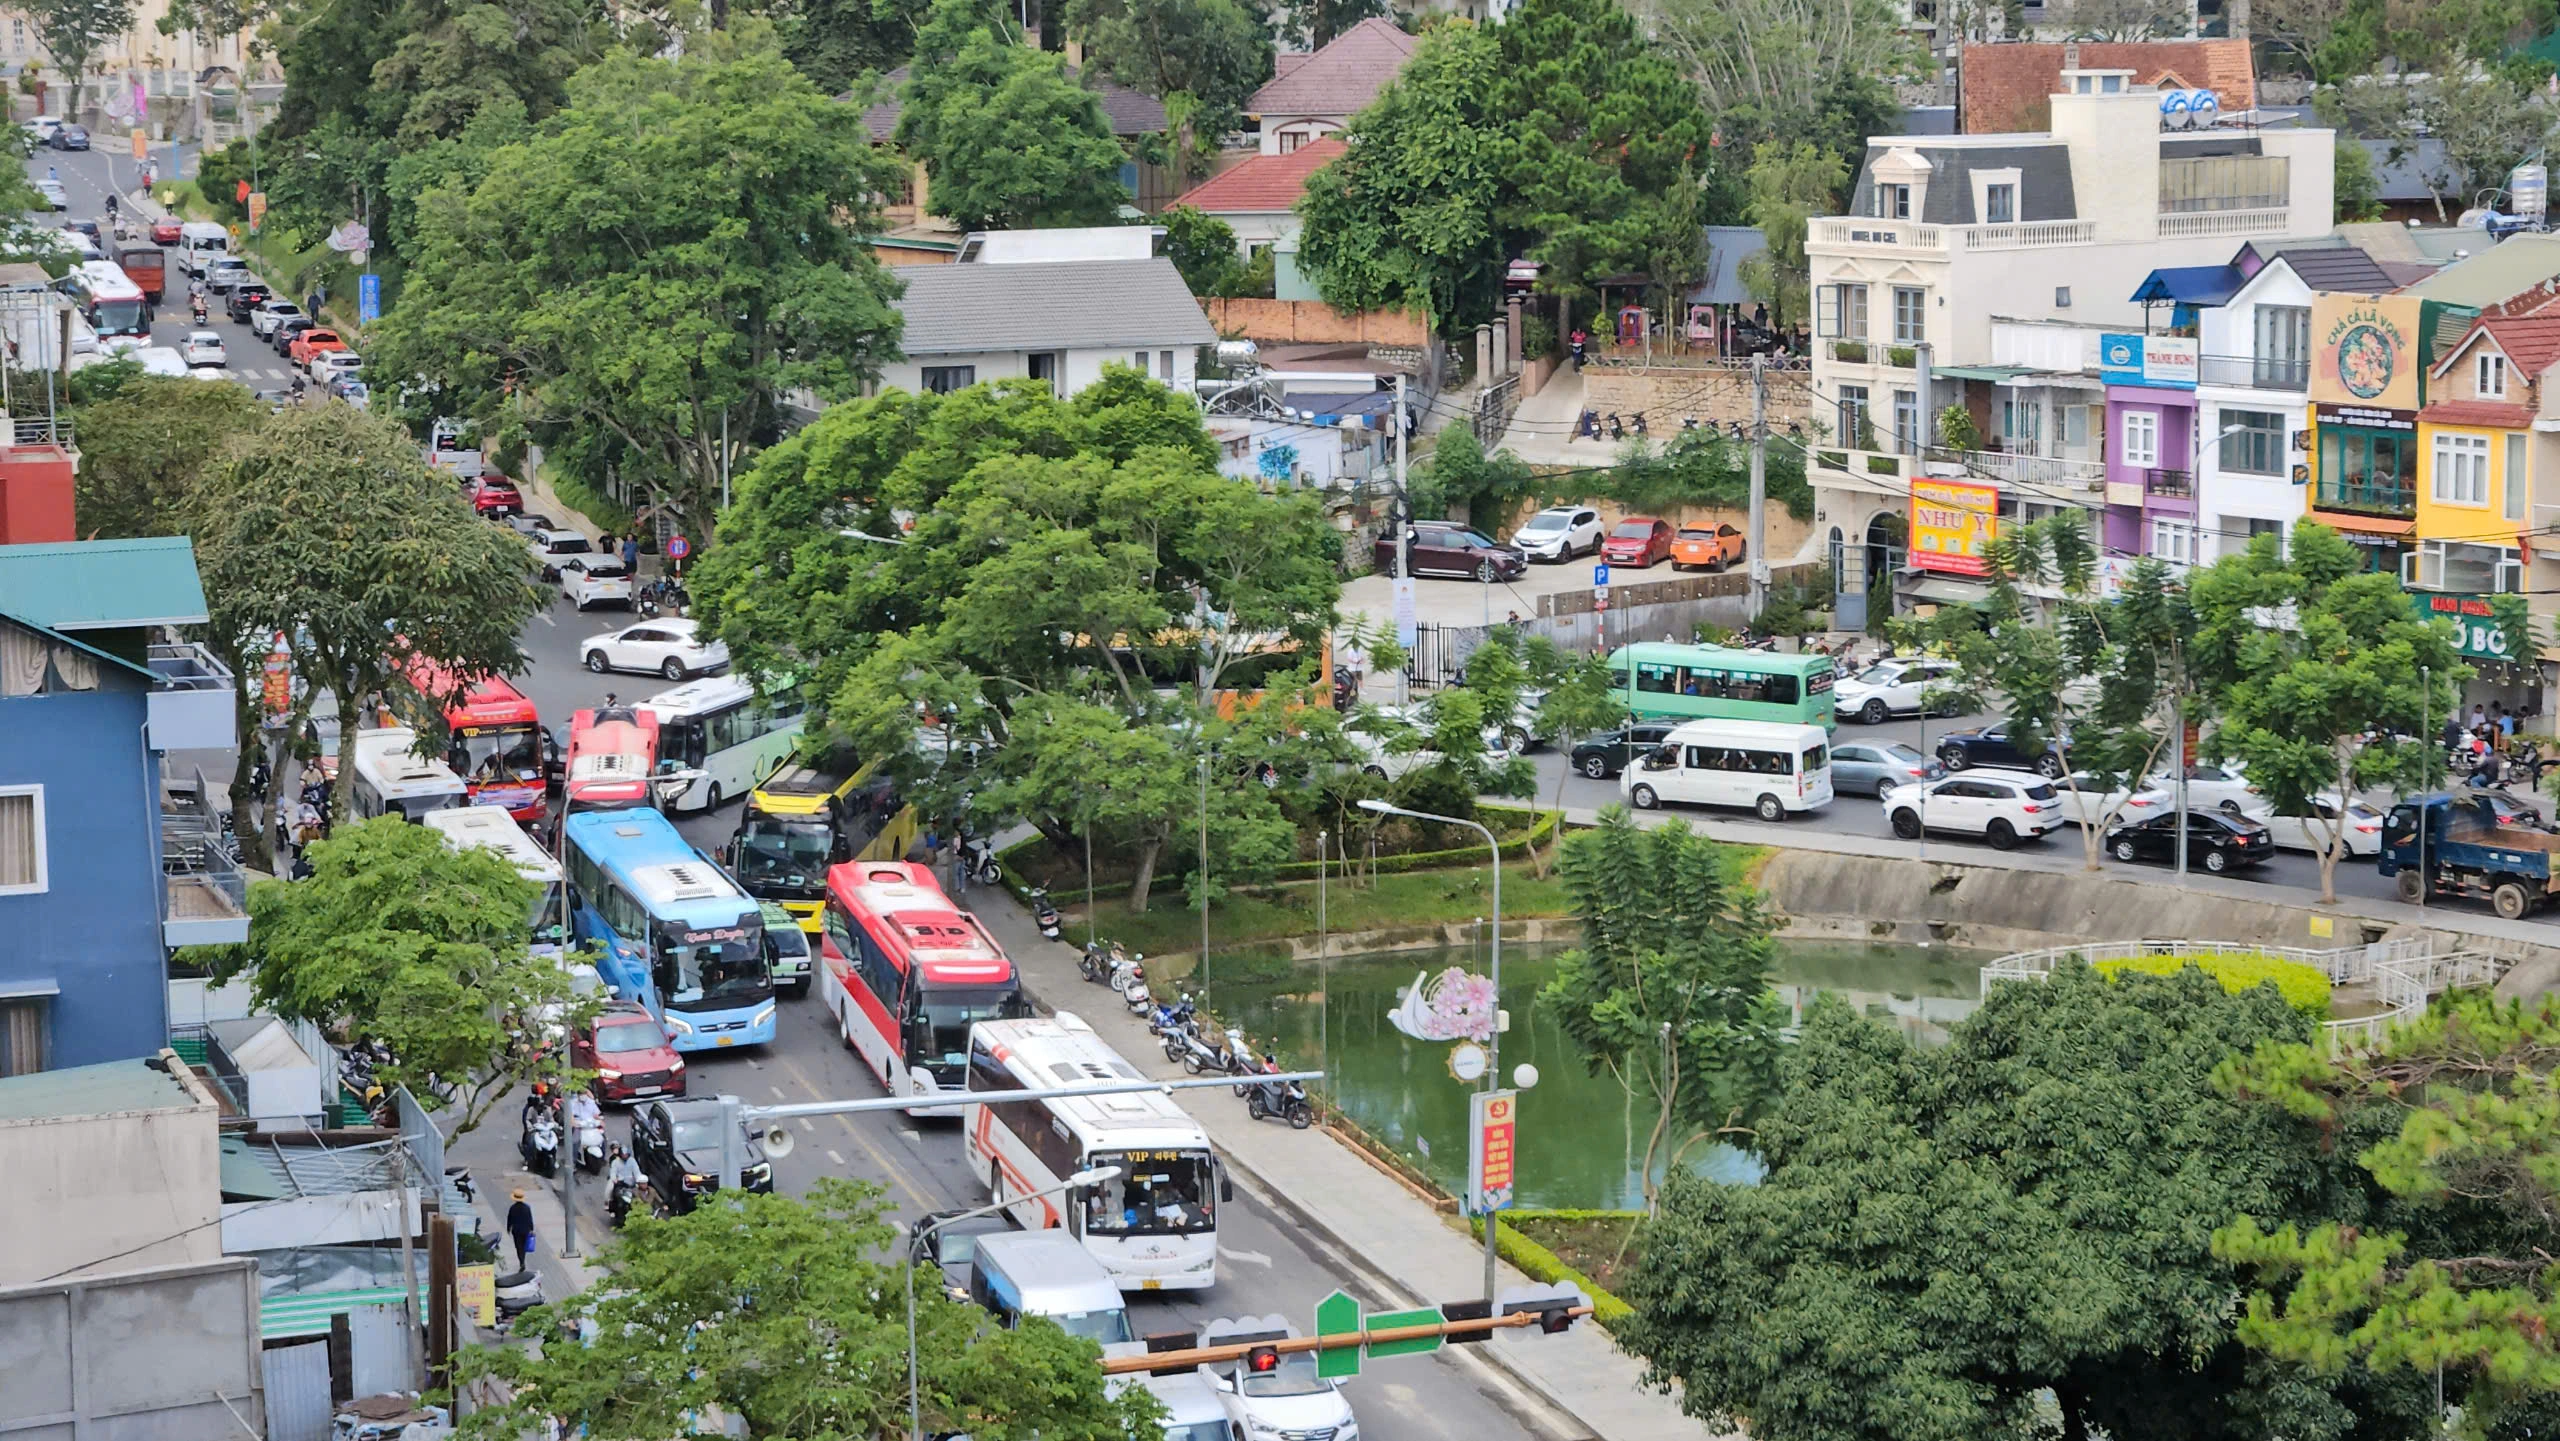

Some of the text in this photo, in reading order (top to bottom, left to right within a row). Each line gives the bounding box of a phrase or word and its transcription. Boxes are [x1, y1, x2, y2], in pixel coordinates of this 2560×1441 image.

[2363, 307, 2377, 323] LÃ
[1597, 568, 1605, 583] P
[462, 727, 480, 737] VIP
[1126, 1151, 1149, 1162] VIP
